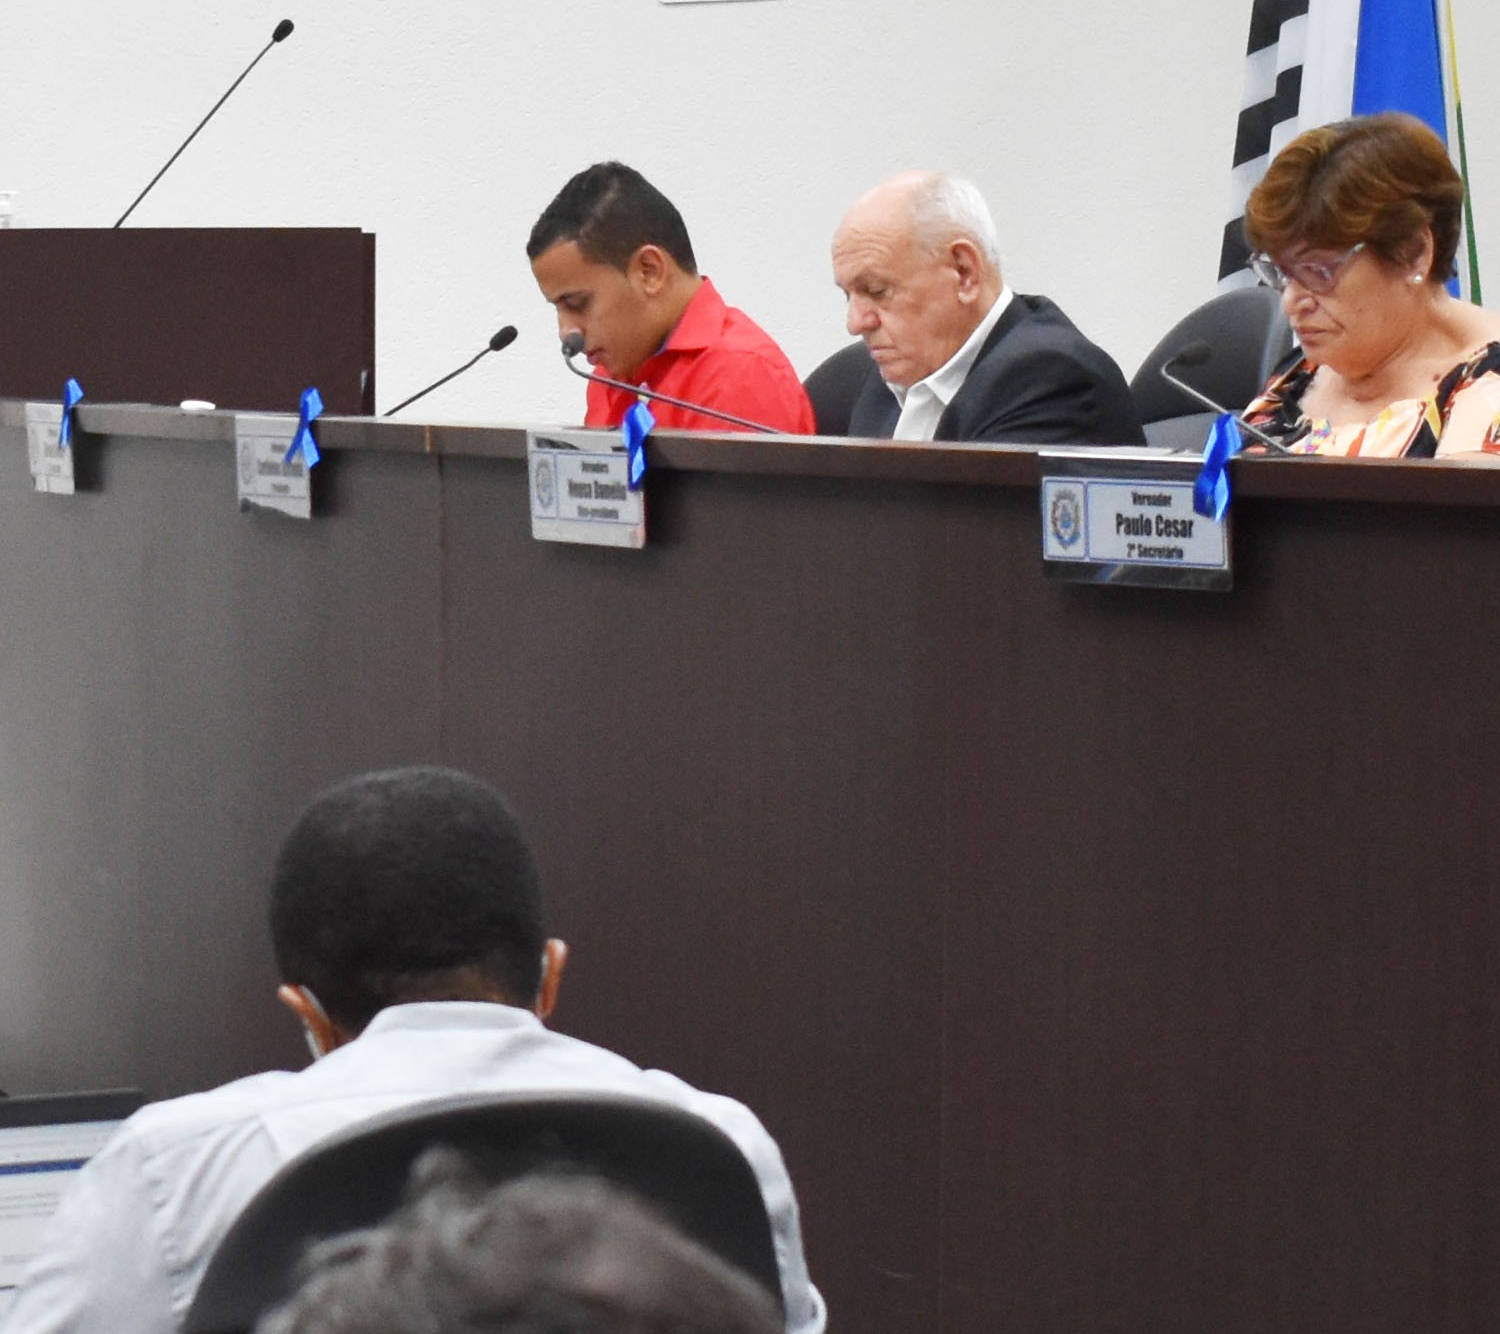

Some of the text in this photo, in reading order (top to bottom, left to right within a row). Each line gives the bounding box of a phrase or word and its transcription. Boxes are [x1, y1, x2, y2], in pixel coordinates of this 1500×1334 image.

[1116, 512, 1194, 539] Paulo Cesar
[1137, 543, 1184, 560] Secretário
